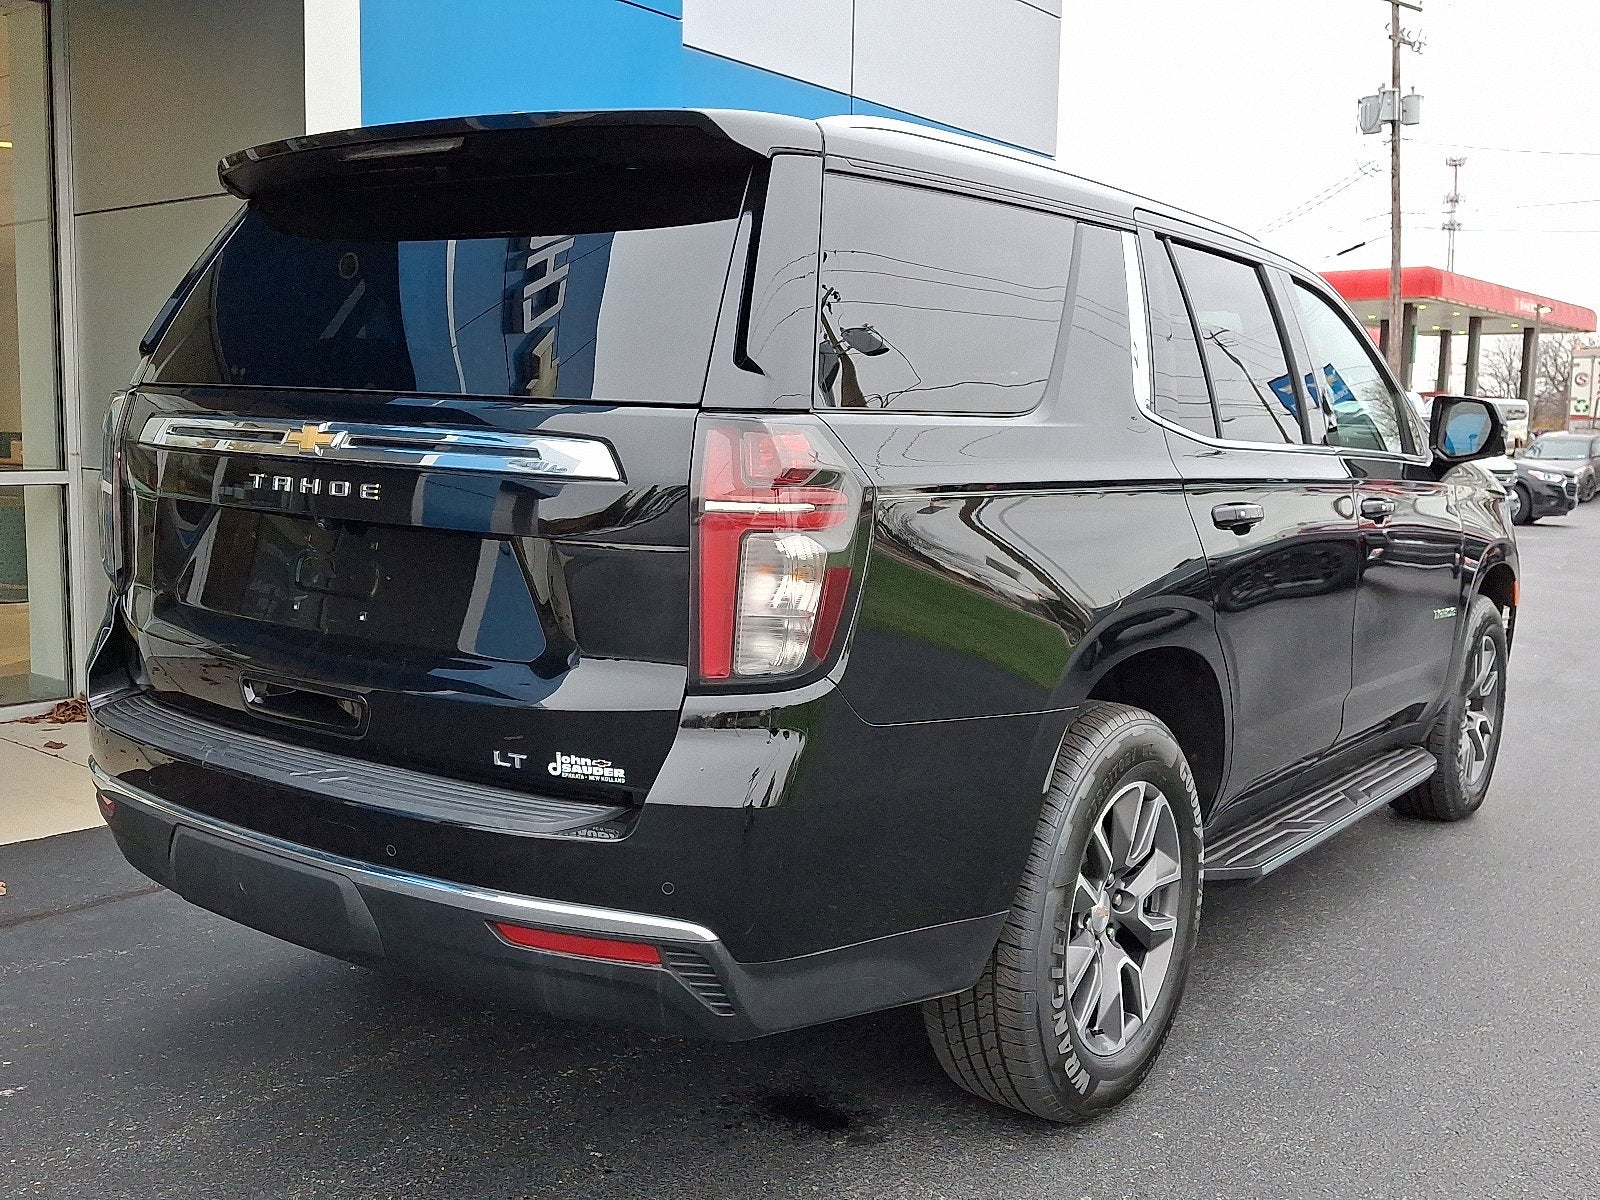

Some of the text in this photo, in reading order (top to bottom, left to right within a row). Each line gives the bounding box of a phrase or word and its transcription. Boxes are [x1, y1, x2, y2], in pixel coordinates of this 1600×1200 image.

[249, 473, 382, 501] TAHOE
[493, 750, 528, 769] LT
[561, 763, 626, 778] SAUDER
